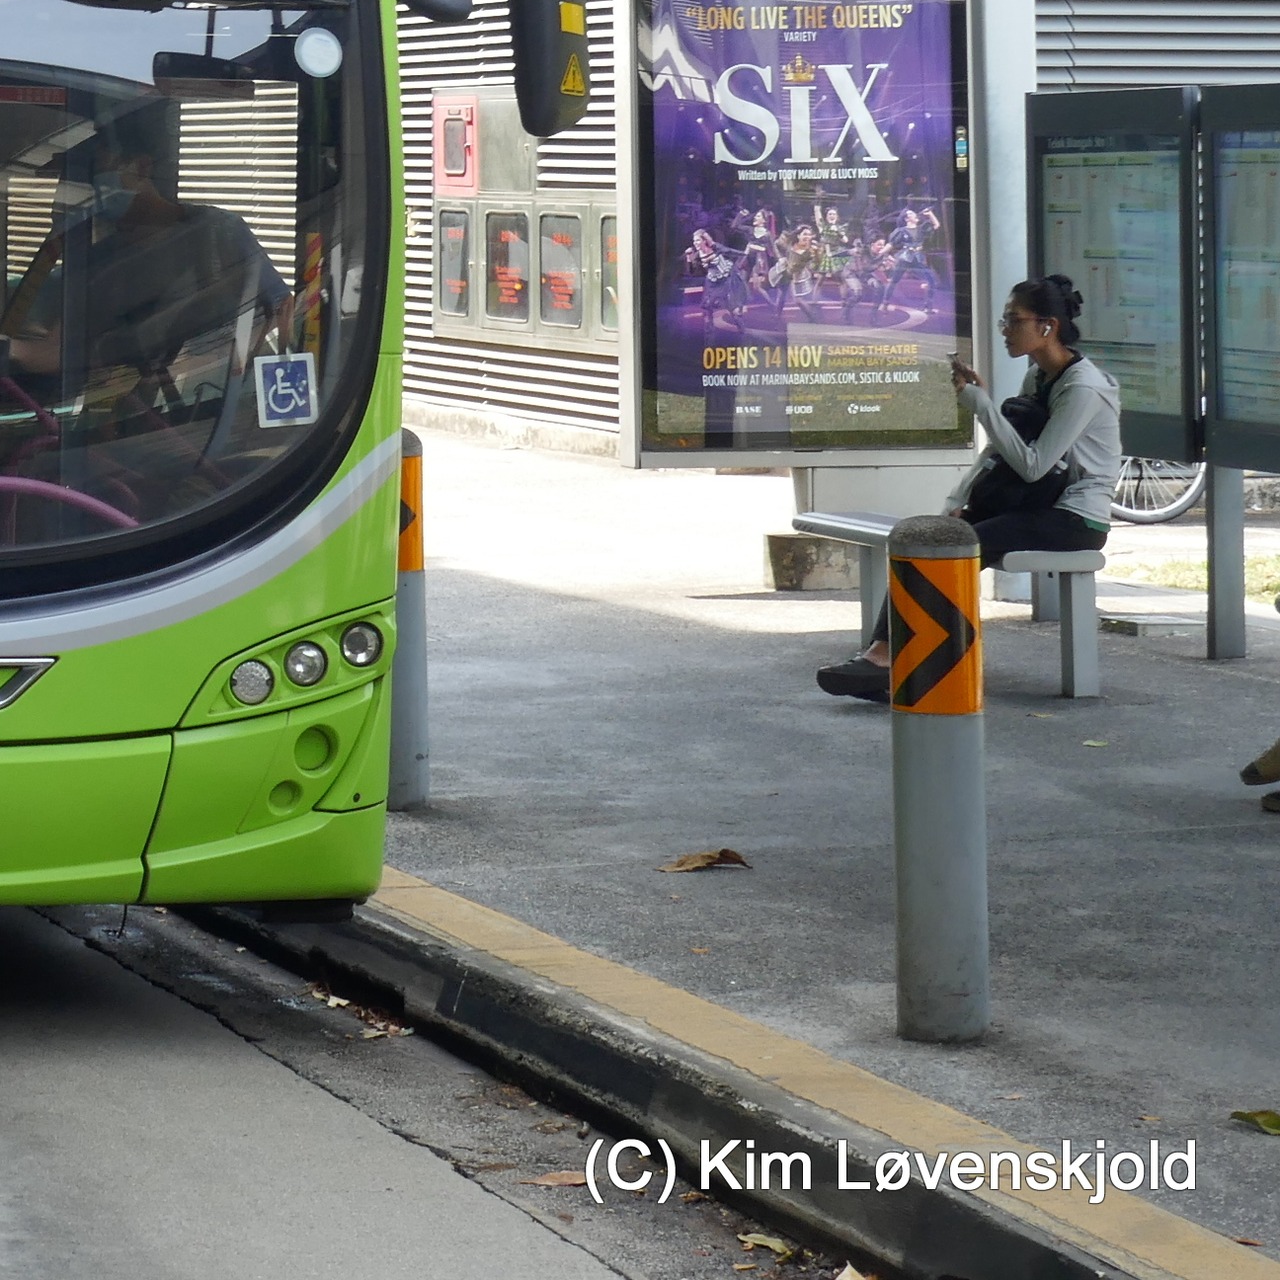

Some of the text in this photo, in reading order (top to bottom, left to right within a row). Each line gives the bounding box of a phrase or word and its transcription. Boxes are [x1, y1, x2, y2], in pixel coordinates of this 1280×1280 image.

[751, 6, 789, 30] LIVE
[793, 6, 827, 30] THE
[784, 31, 817, 42] VARIETY
[737, 167, 878, 181] Written by TOBY MARLOW & LUCY MOSS
[827, 344, 918, 356] SANDS THEATRE
[703, 345, 823, 369] OPENS 14 NOV
[827, 355, 918, 367] MARINA BAY SANDS
[702, 375, 726, 387] BOOK
[727, 374, 747, 386] NOW
[749, 374, 760, 386] AT
[859, 372, 883, 384] SISTIC
[884, 372, 892, 383] &
[892, 371, 920, 383] KLOOK
[793, 405, 813, 414] UOB
[859, 405, 881, 413] klook
